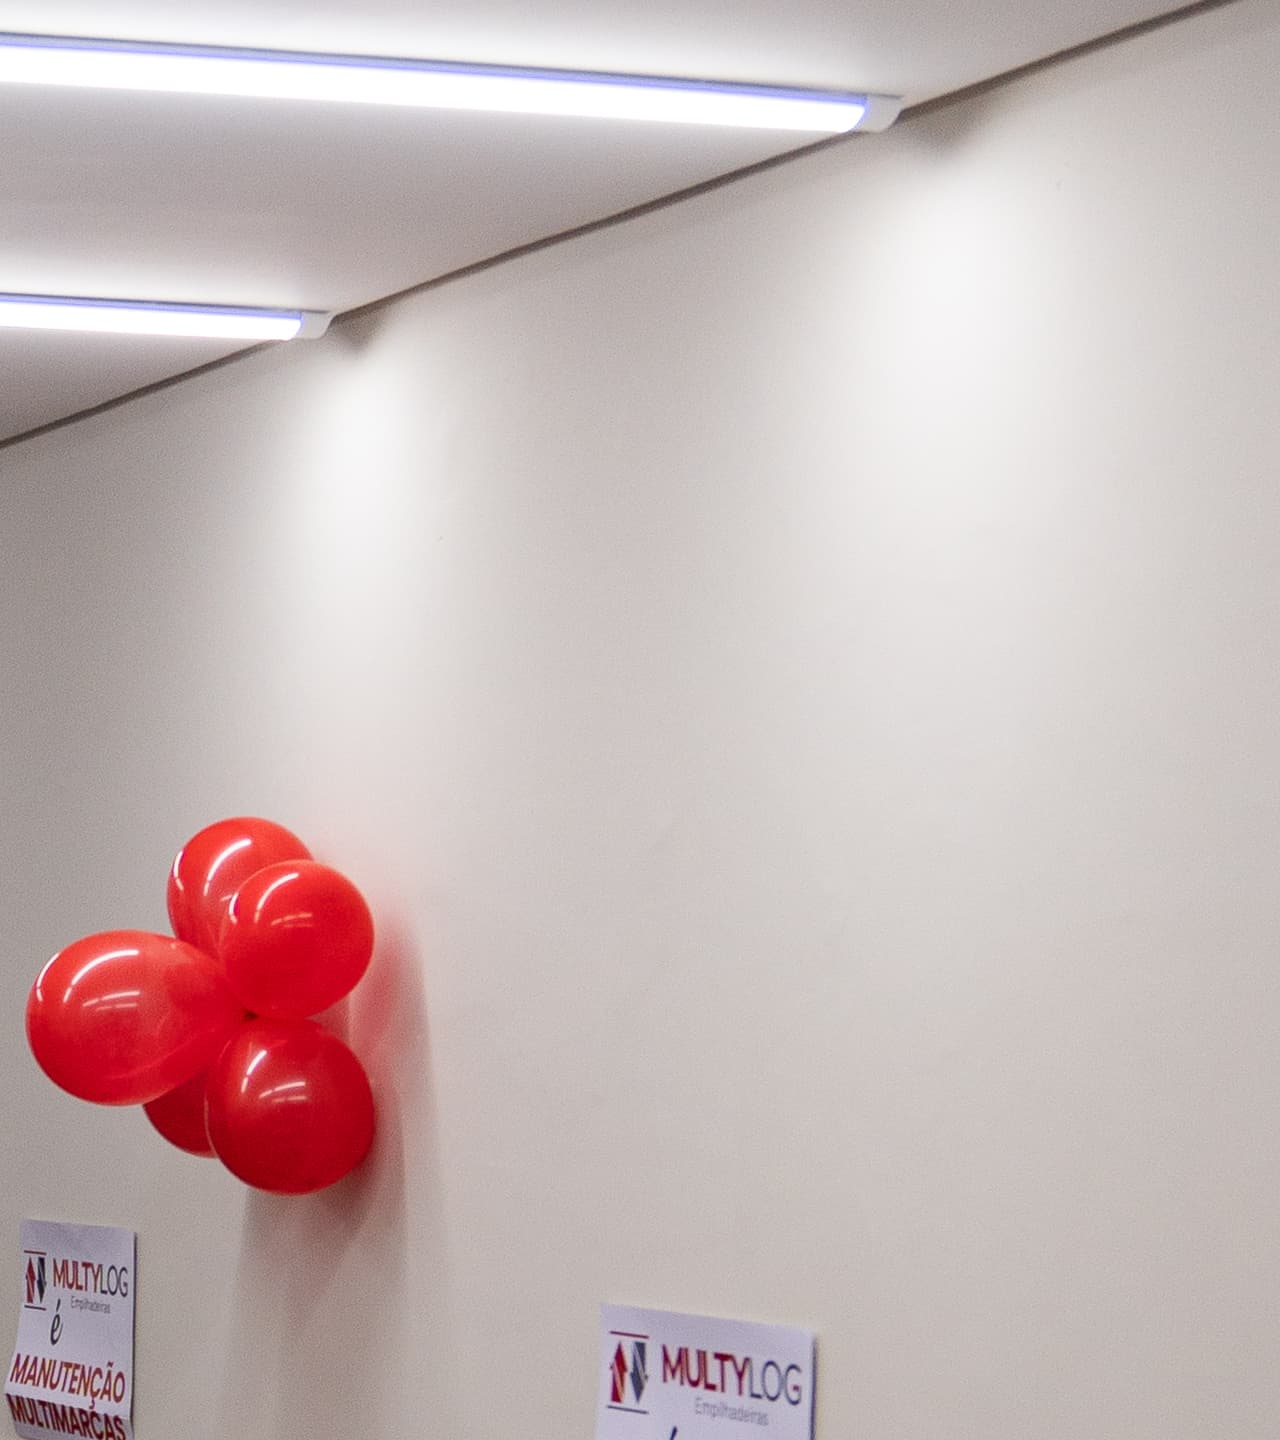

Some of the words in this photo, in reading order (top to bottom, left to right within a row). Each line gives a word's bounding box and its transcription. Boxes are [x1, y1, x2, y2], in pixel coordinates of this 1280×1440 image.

[52, 1257, 128, 1298] MULTYLOG
[50, 1298, 64, 1346] é
[9, 1353, 126, 1410] MANUTENÇÃO
[661, 1344, 803, 1406] MULTYLOG
